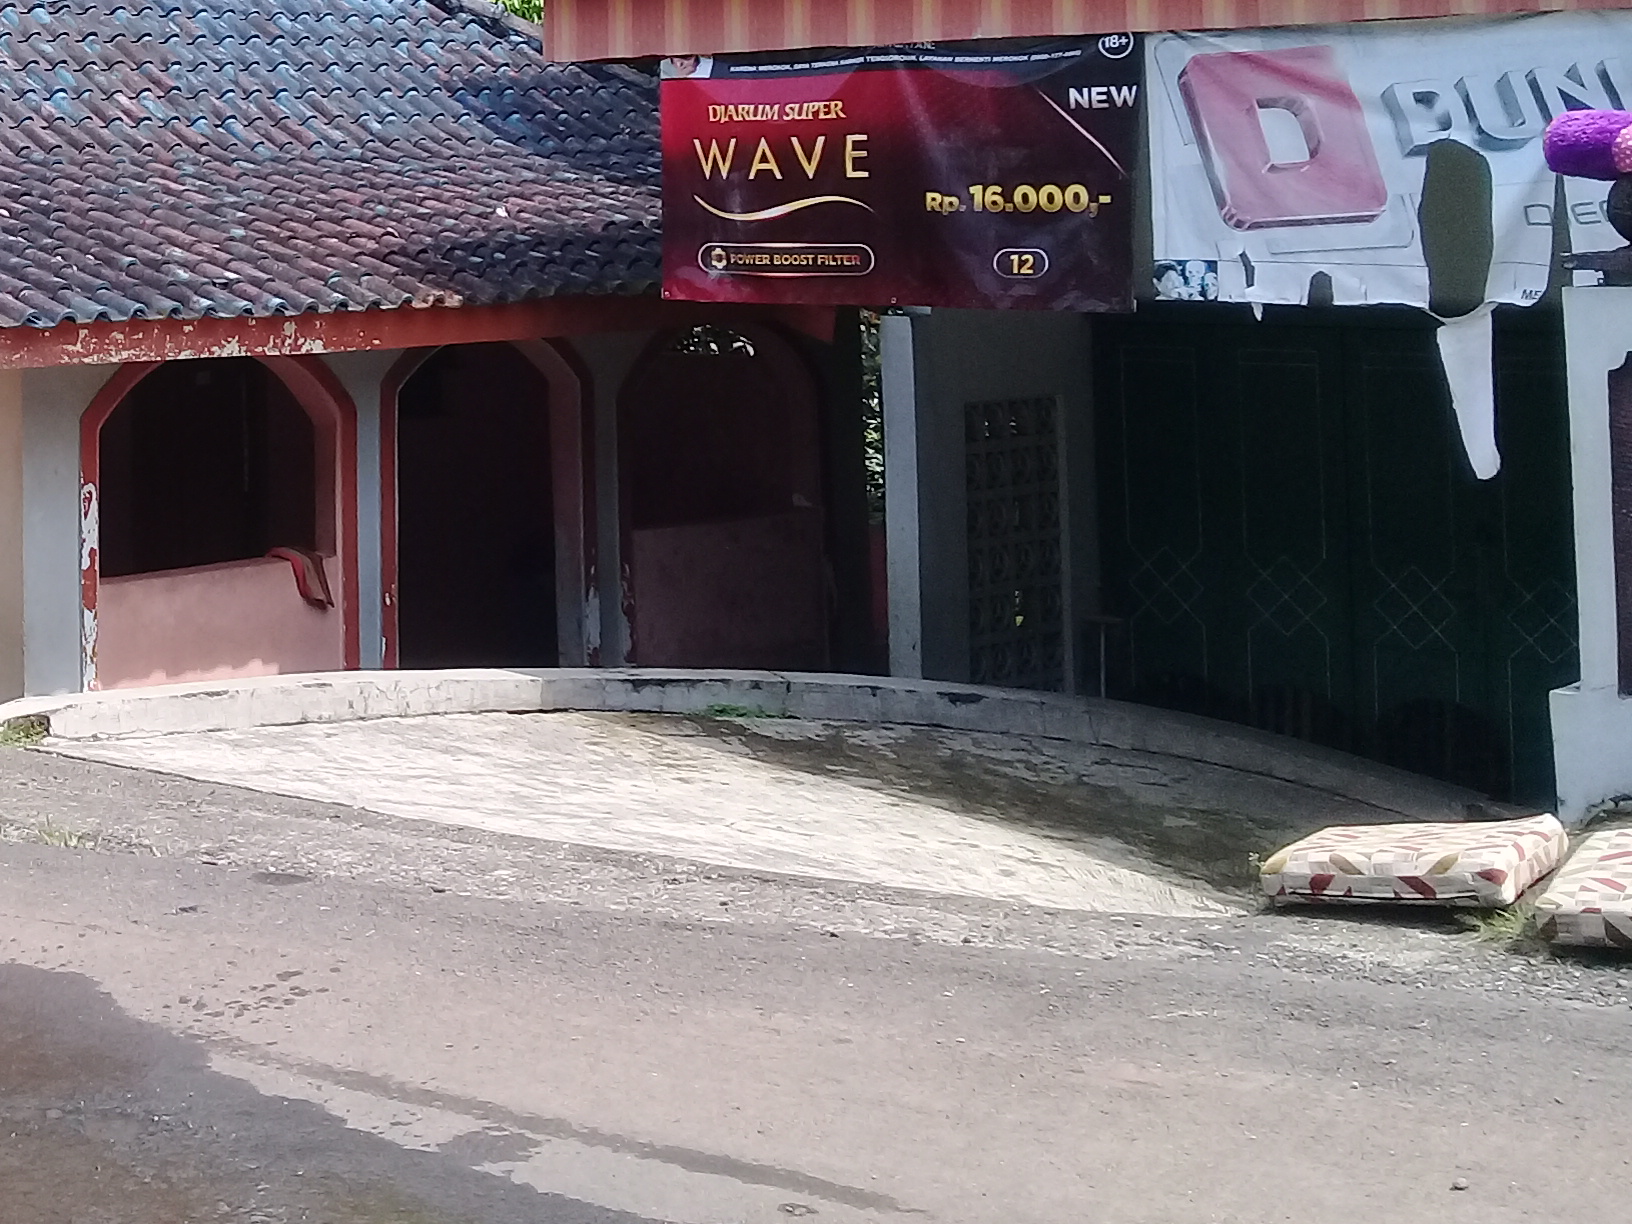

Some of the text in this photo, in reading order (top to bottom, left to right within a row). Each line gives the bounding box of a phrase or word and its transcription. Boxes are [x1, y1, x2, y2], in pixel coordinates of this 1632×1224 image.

[1103, 35, 1129, 49] 18+
[1068, 85, 1137, 110] NEW
[708, 100, 847, 123] DJARUM SUPER
[692, 134, 870, 180] WAVE
[925, 183, 1112, 218] Rp. 16.000,-
[729, 254, 861, 266] POWER BOOST FILTER
[1009, 254, 1035, 274] 12
